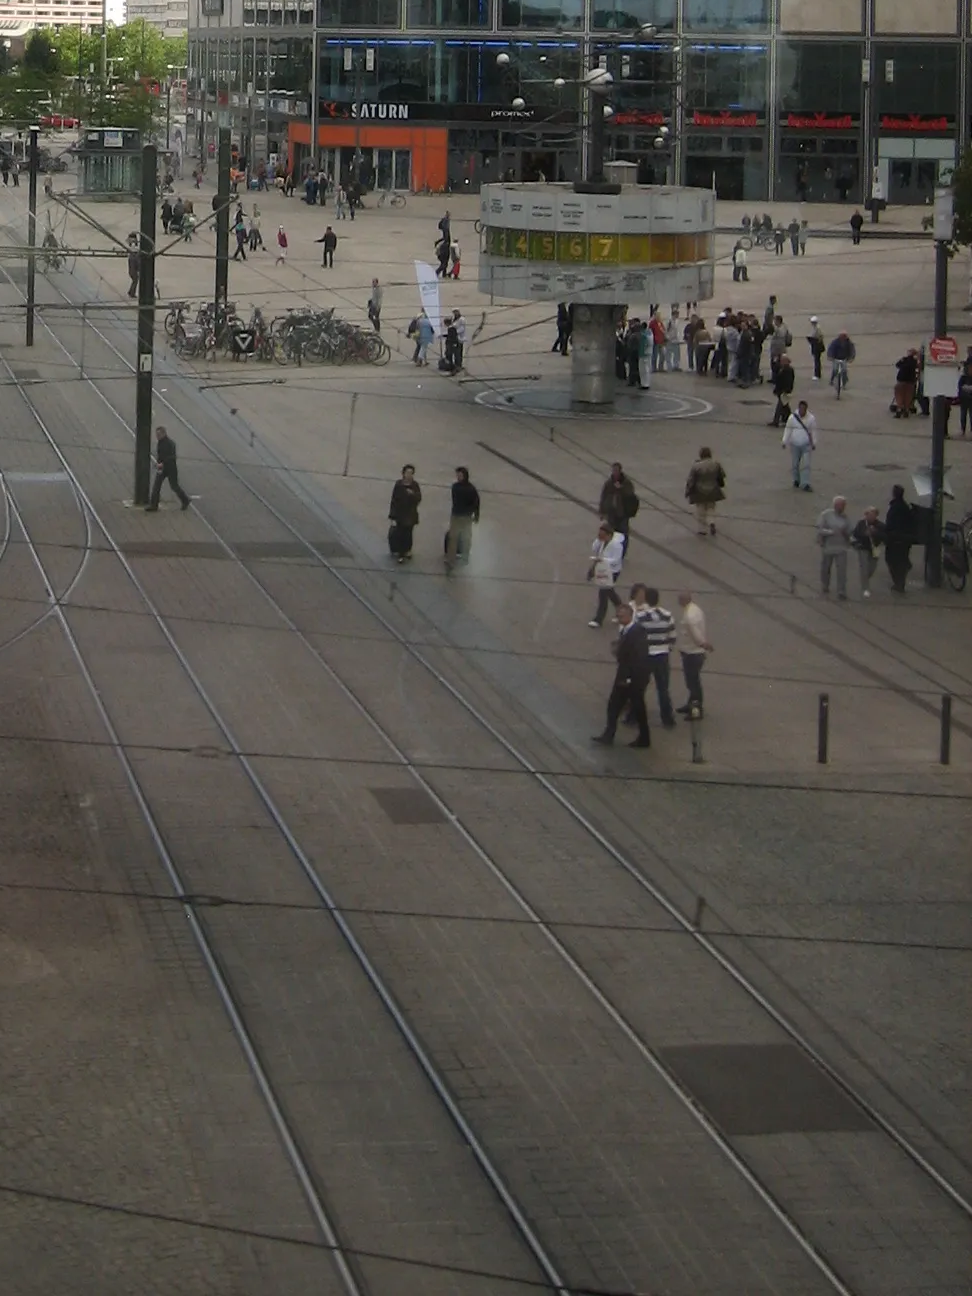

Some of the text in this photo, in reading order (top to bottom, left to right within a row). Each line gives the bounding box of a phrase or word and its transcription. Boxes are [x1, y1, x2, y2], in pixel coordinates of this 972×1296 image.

[351, 102, 409, 119] SATURN
[542, 237, 553, 255] 5
[570, 238, 583, 257] 6
[598, 238, 613, 257] 7
